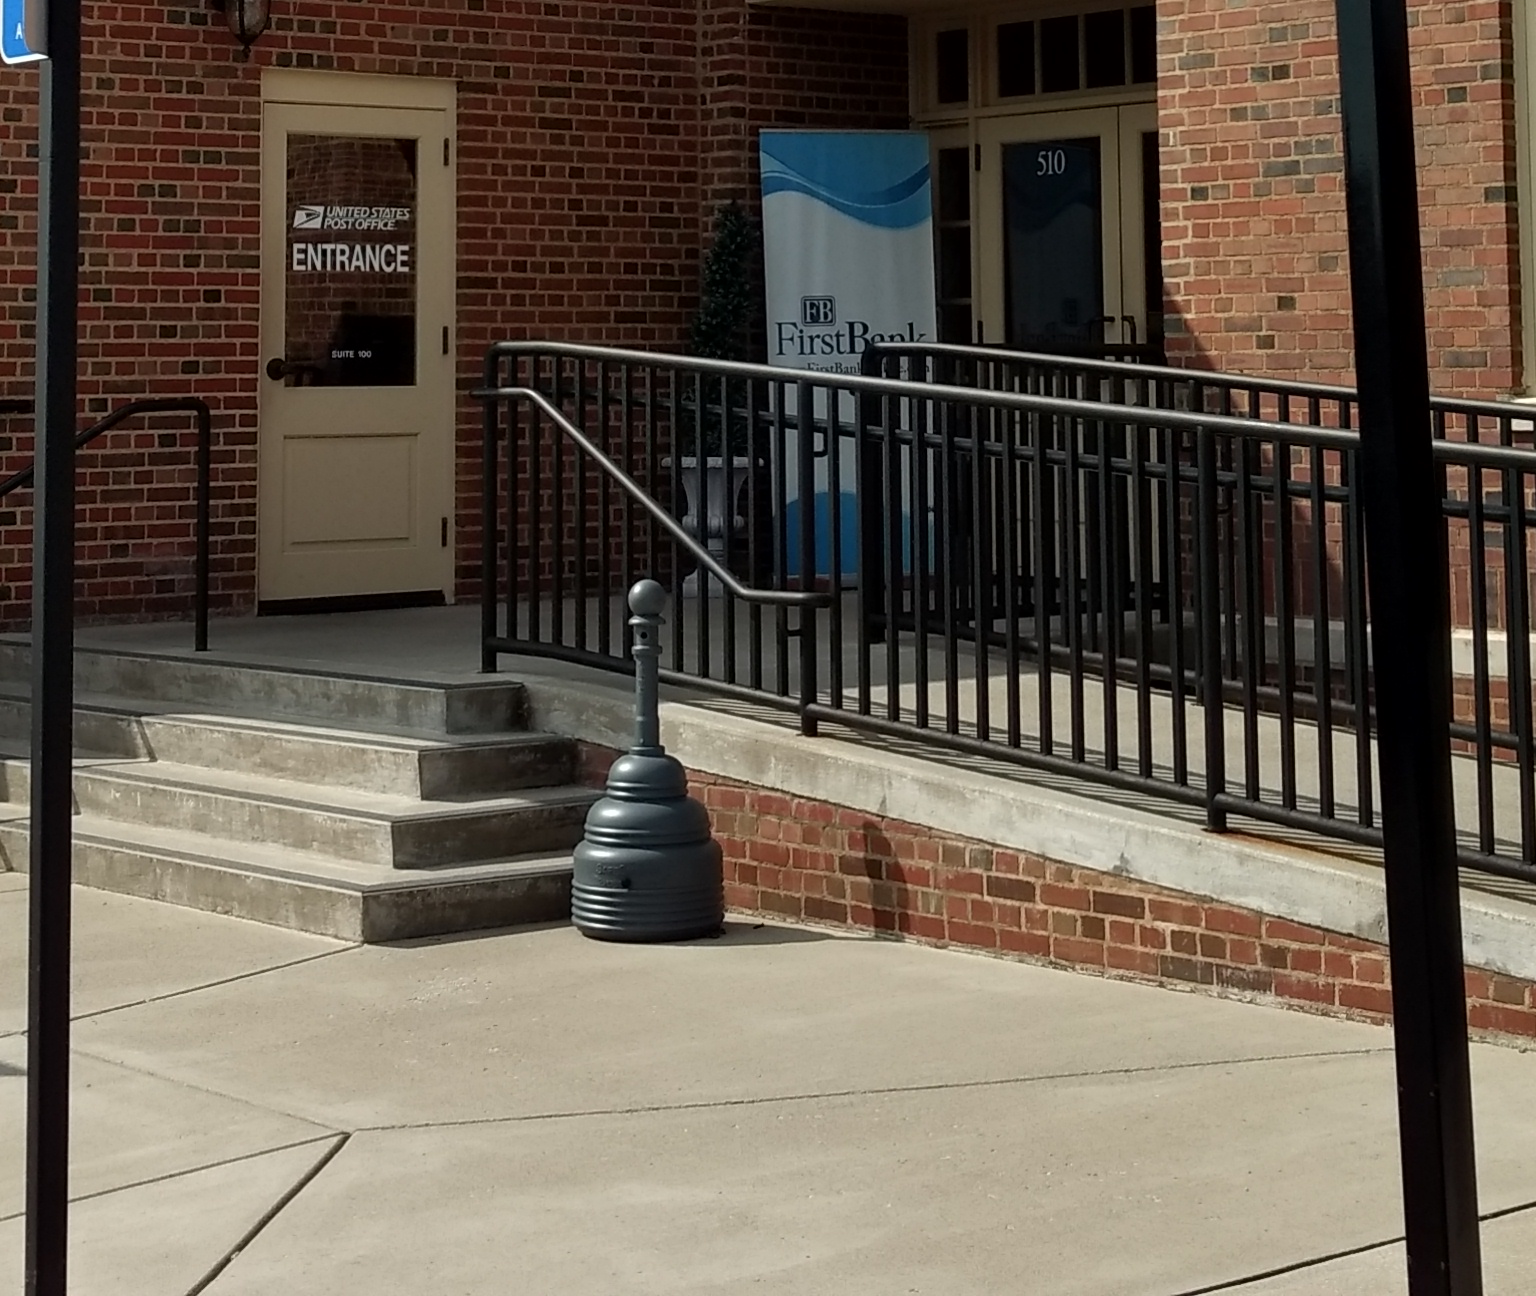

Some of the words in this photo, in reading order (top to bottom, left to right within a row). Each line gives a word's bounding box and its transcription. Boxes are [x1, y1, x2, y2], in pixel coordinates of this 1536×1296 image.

[1036, 149, 1065, 176] 510
[326, 205, 370, 218] UNITED
[371, 207, 411, 220] STATES
[323, 218, 354, 230] POST
[355, 219, 396, 231] OFFICE
[292, 243, 410, 273] ENTRANCE
[803, 298, 834, 324] FB
[331, 350, 355, 359] SUITE
[358, 350, 372, 359] 100
